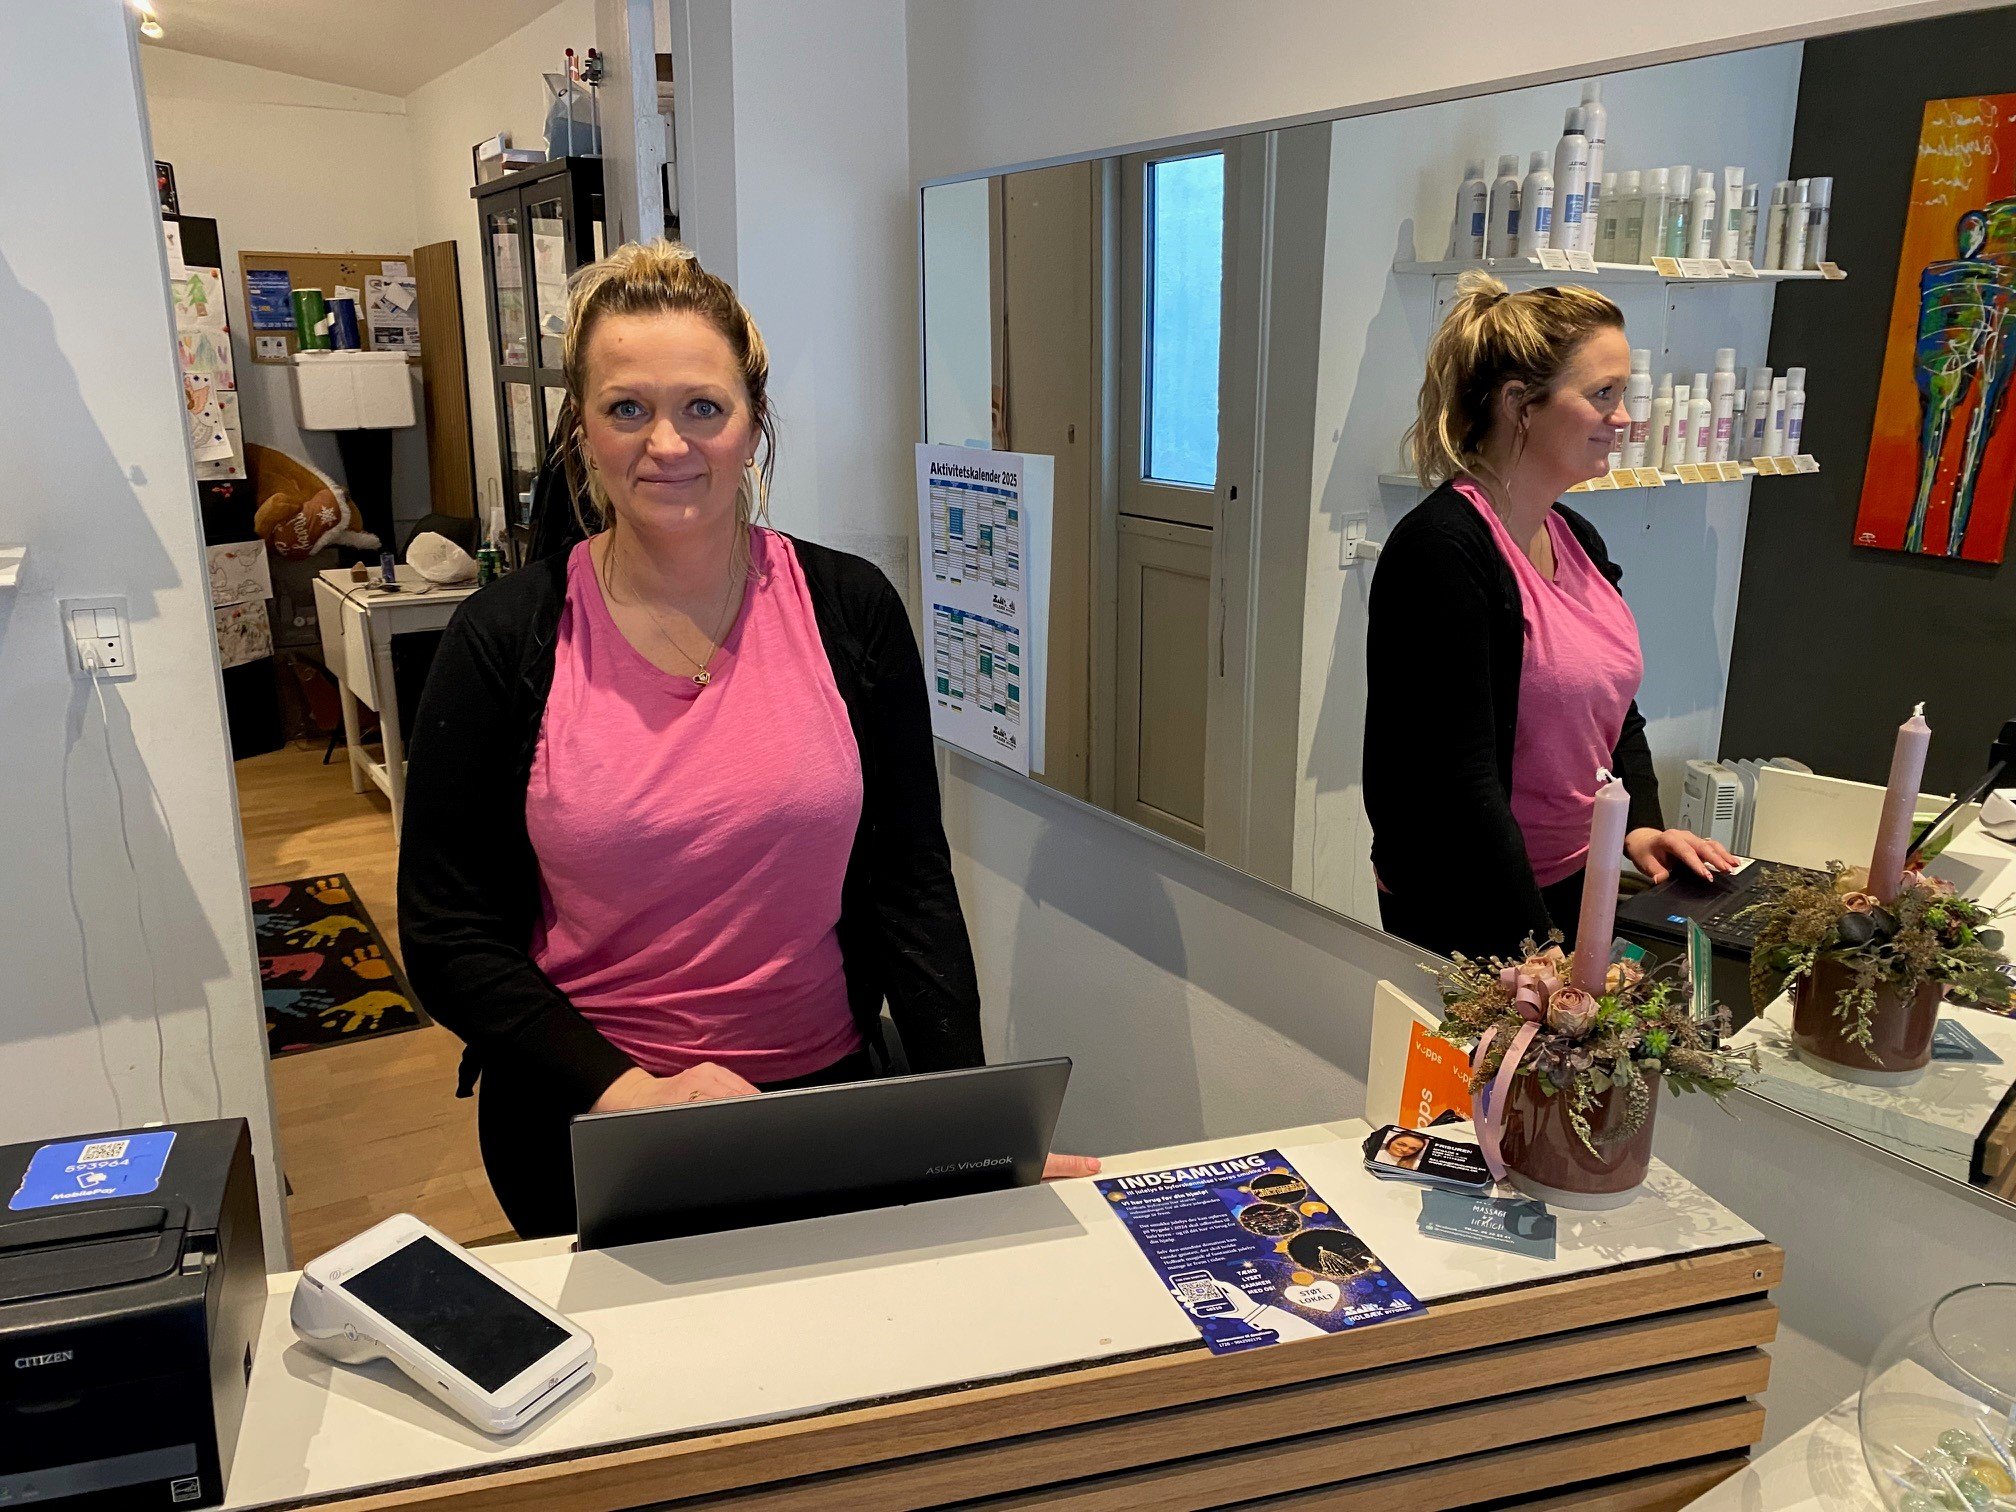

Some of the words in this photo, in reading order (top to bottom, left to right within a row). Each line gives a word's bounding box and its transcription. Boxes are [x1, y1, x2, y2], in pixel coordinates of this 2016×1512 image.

[930, 461, 1001, 483] Aktivitetskalender
[1002, 471, 1018, 488] 2025
[1415, 1041, 1443, 1064] vipps
[64, 1158, 130, 1173] 593964
[925, 1164, 956, 1175] ASUS
[957, 1156, 1013, 1170] VivoBook
[1117, 1155, 1266, 1190] INDSAMLING
[50, 1187, 116, 1200] MobilePay
[1135, 1186, 1158, 1195] julelys
[1143, 1197, 1161, 1205] brug
[1472, 1205, 1507, 1218] MASSAGE
[1241, 1280, 1272, 1289] SAMMEN
[1242, 1274, 1262, 1282] LYSET
[1299, 1294, 1334, 1304] LOKALT
[1300, 1288, 1322, 1297] STØT
[1348, 1311, 1384, 1322] HOLBÆK
[14, 1350, 74, 1370] CITIZEN
